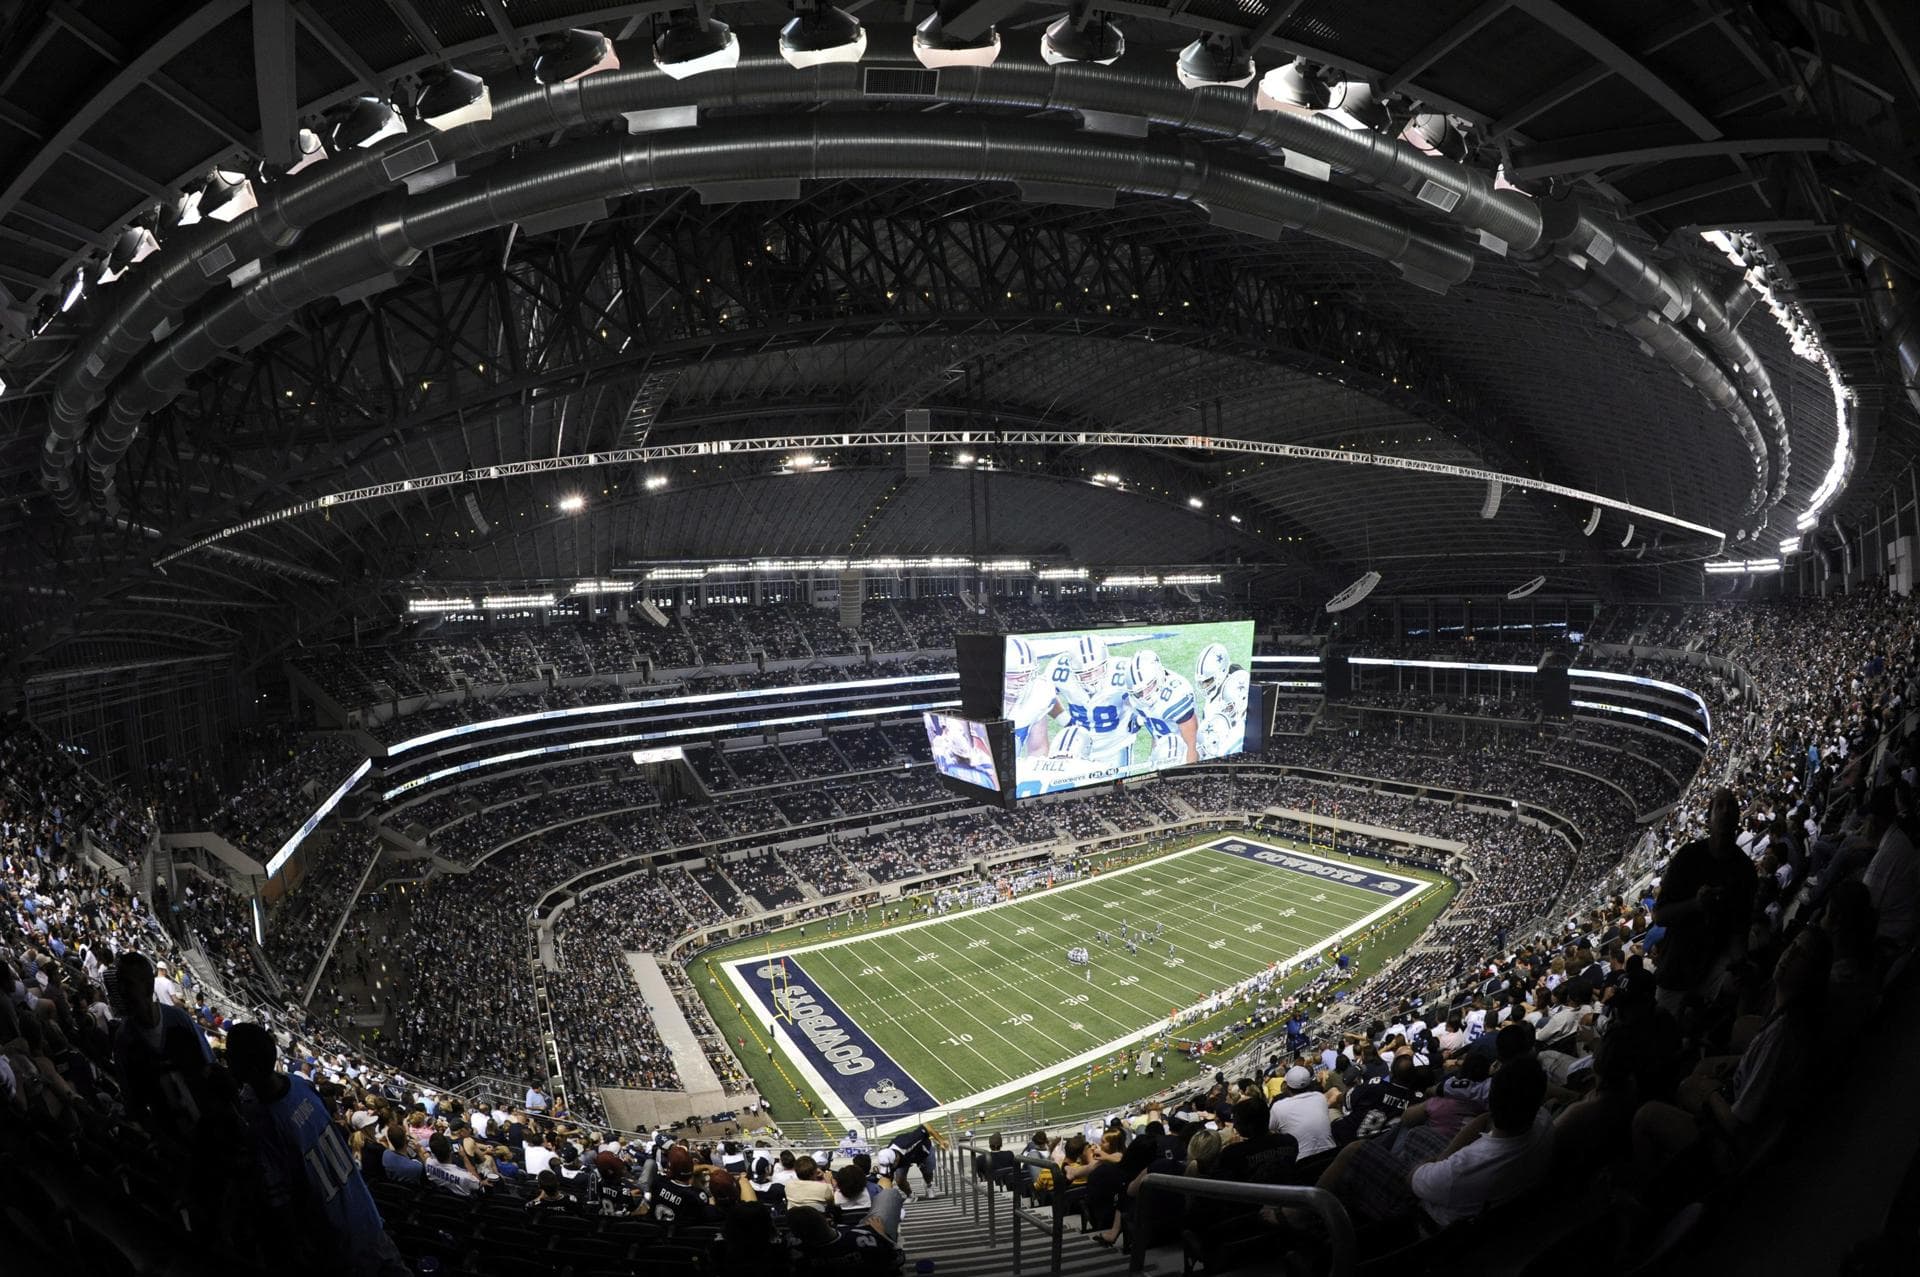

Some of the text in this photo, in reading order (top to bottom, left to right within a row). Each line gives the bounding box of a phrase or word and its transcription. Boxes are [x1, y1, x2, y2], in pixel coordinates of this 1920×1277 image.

[1254, 851, 1367, 883] COWBOYS
[771, 985, 875, 1076] COWBOYS
[304, 1124, 354, 1202] 10
[659, 1188, 682, 1206] ROMO
